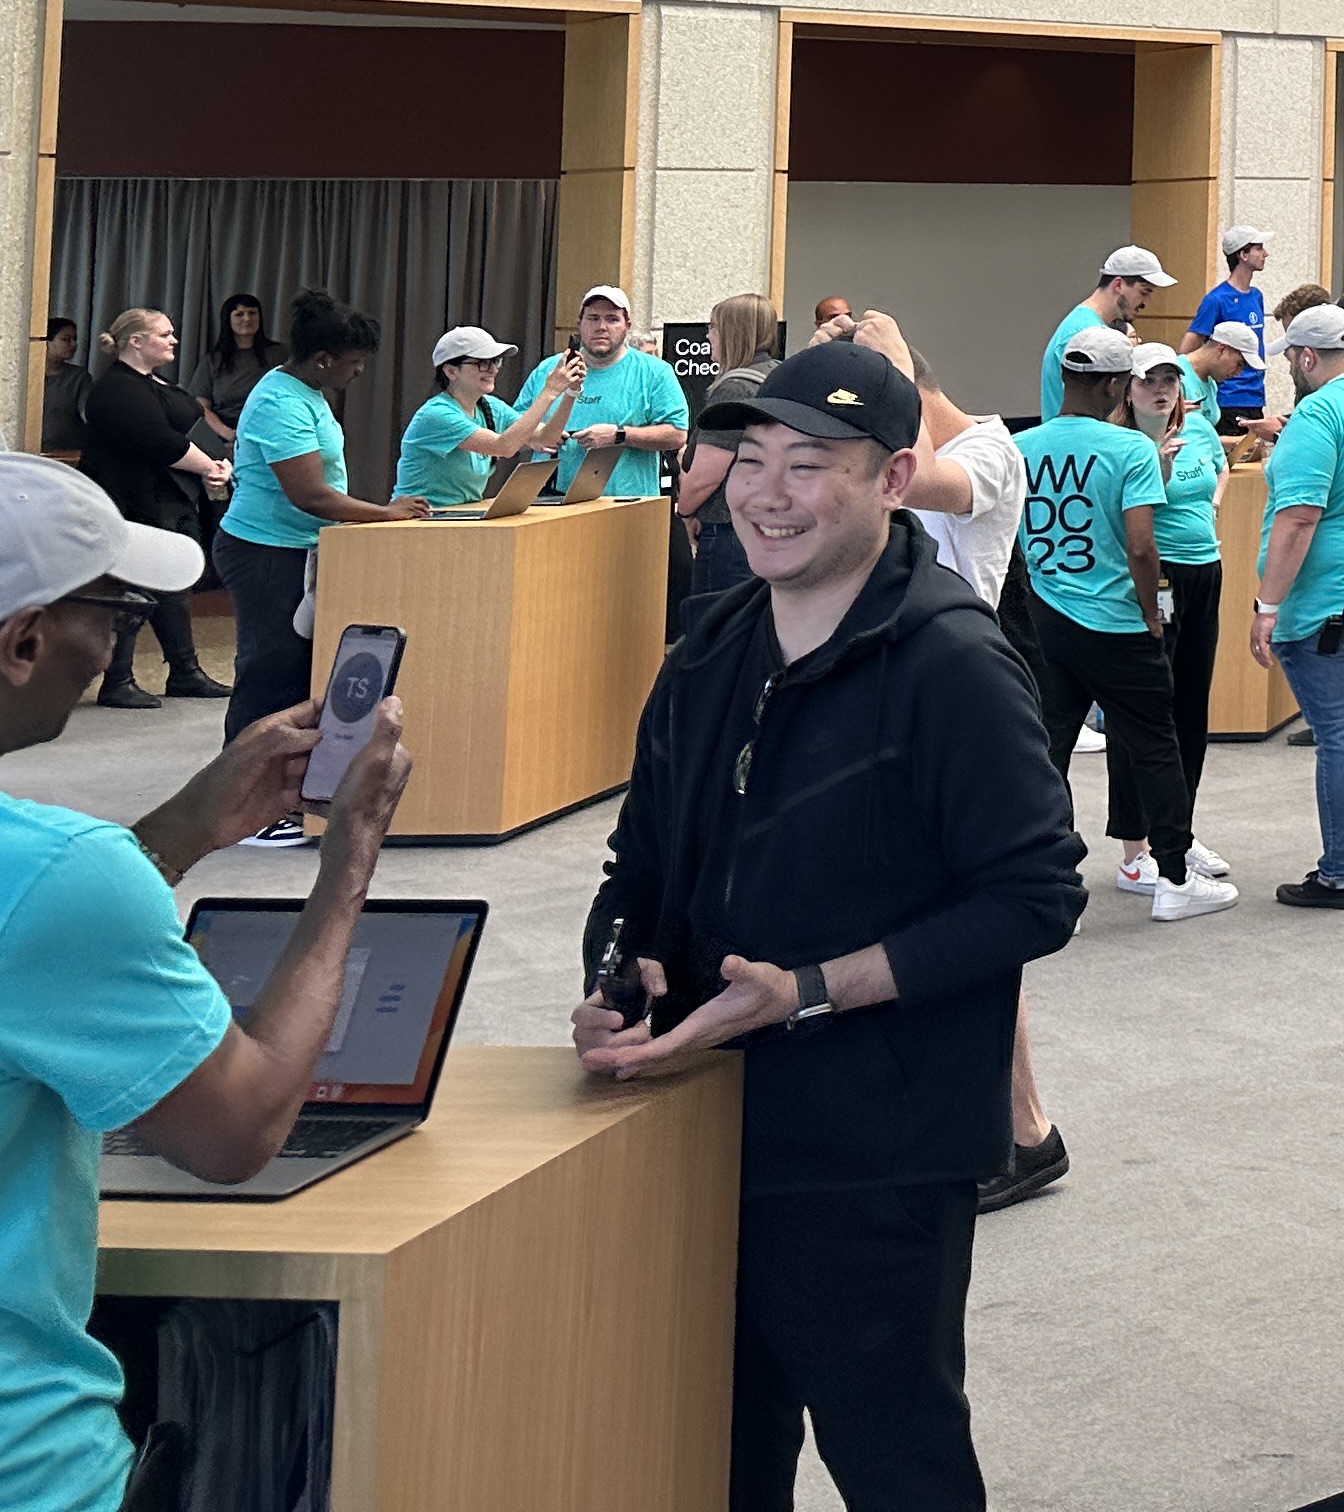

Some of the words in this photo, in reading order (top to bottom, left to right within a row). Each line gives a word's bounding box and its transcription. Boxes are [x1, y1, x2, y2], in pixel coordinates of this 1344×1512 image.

[675, 338, 712, 356] Coa
[674, 358, 721, 376] Chec
[577, 394, 602, 405] Staff
[1176, 466, 1204, 482] Staff
[1024, 494, 1094, 535] DC
[1027, 535, 1096, 576] 23
[346, 676, 370, 699] TS
